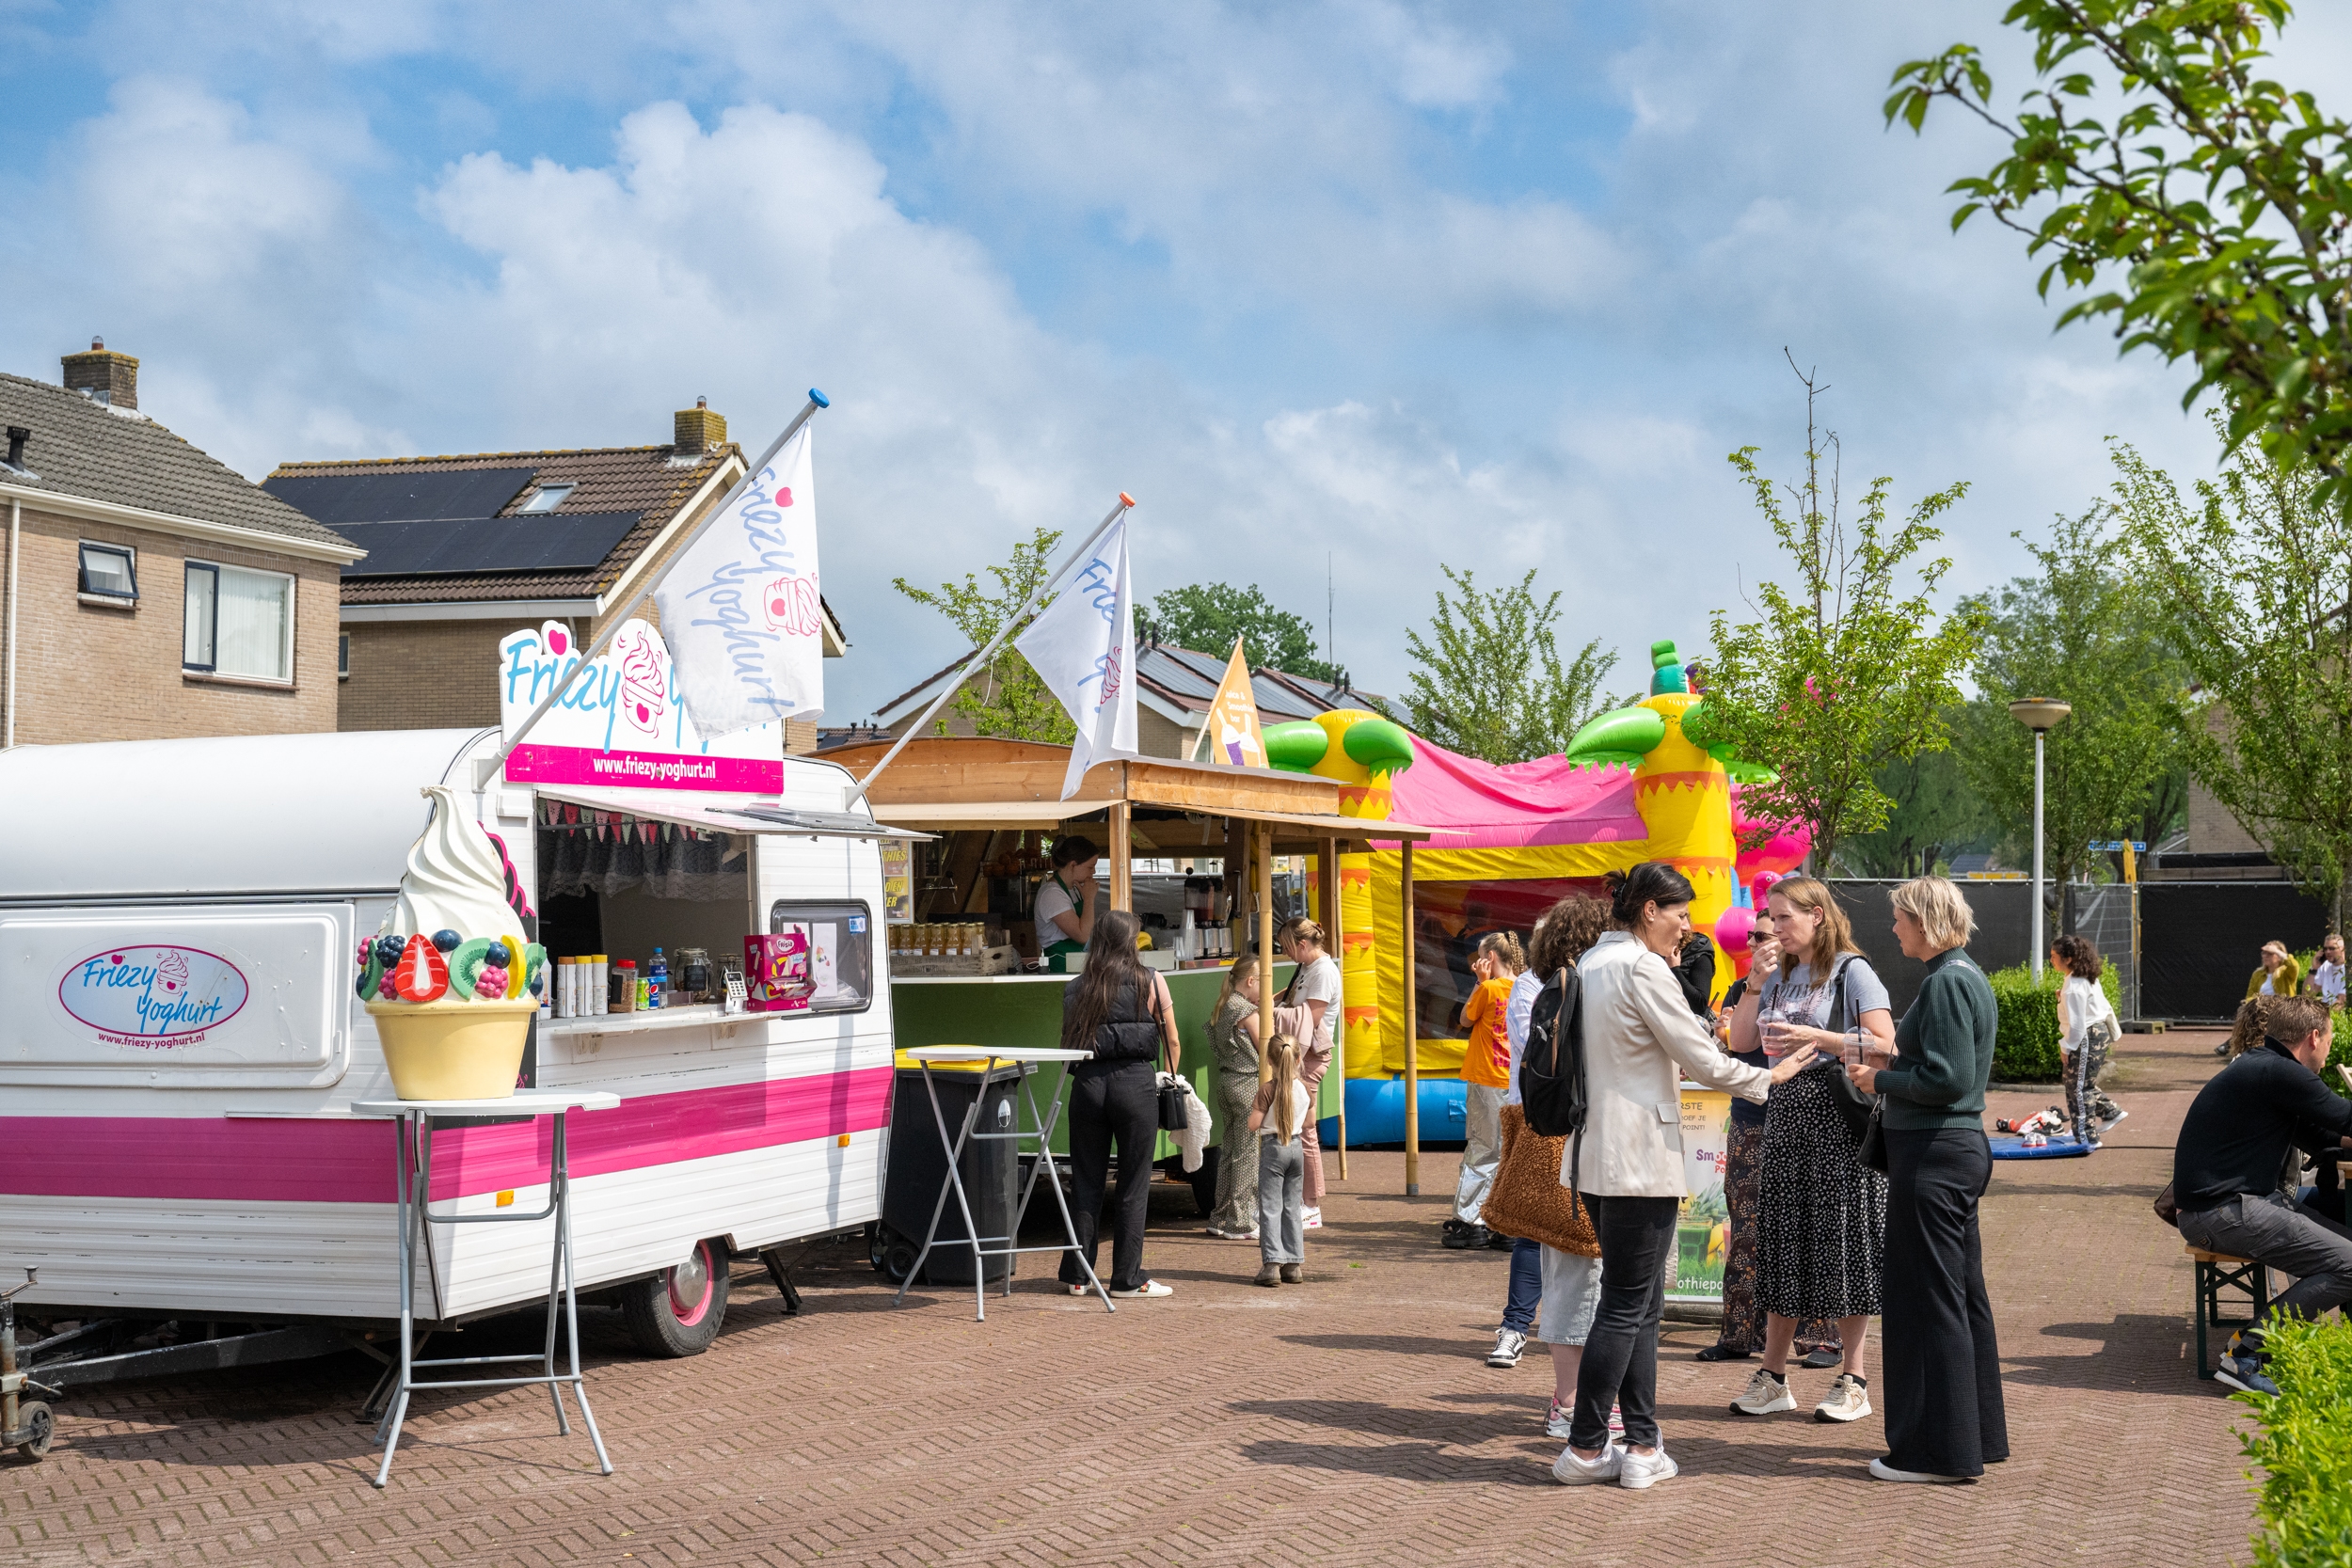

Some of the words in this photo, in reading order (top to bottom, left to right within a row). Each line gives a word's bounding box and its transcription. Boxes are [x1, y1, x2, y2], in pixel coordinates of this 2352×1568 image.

[1225, 689, 1240, 700] Juice
[1240, 691, 1247, 700] &
[1227, 701, 1255, 713] Smoothie
[1230, 713, 1241, 723] bar
[593, 754, 716, 782] www.friezy-yoghurt.nl
[83, 954, 157, 1005] Friezy
[98, 1032, 205, 1050] www.friezy-yoghurt.nl
[1677, 1275, 1724, 1294] othiepo
